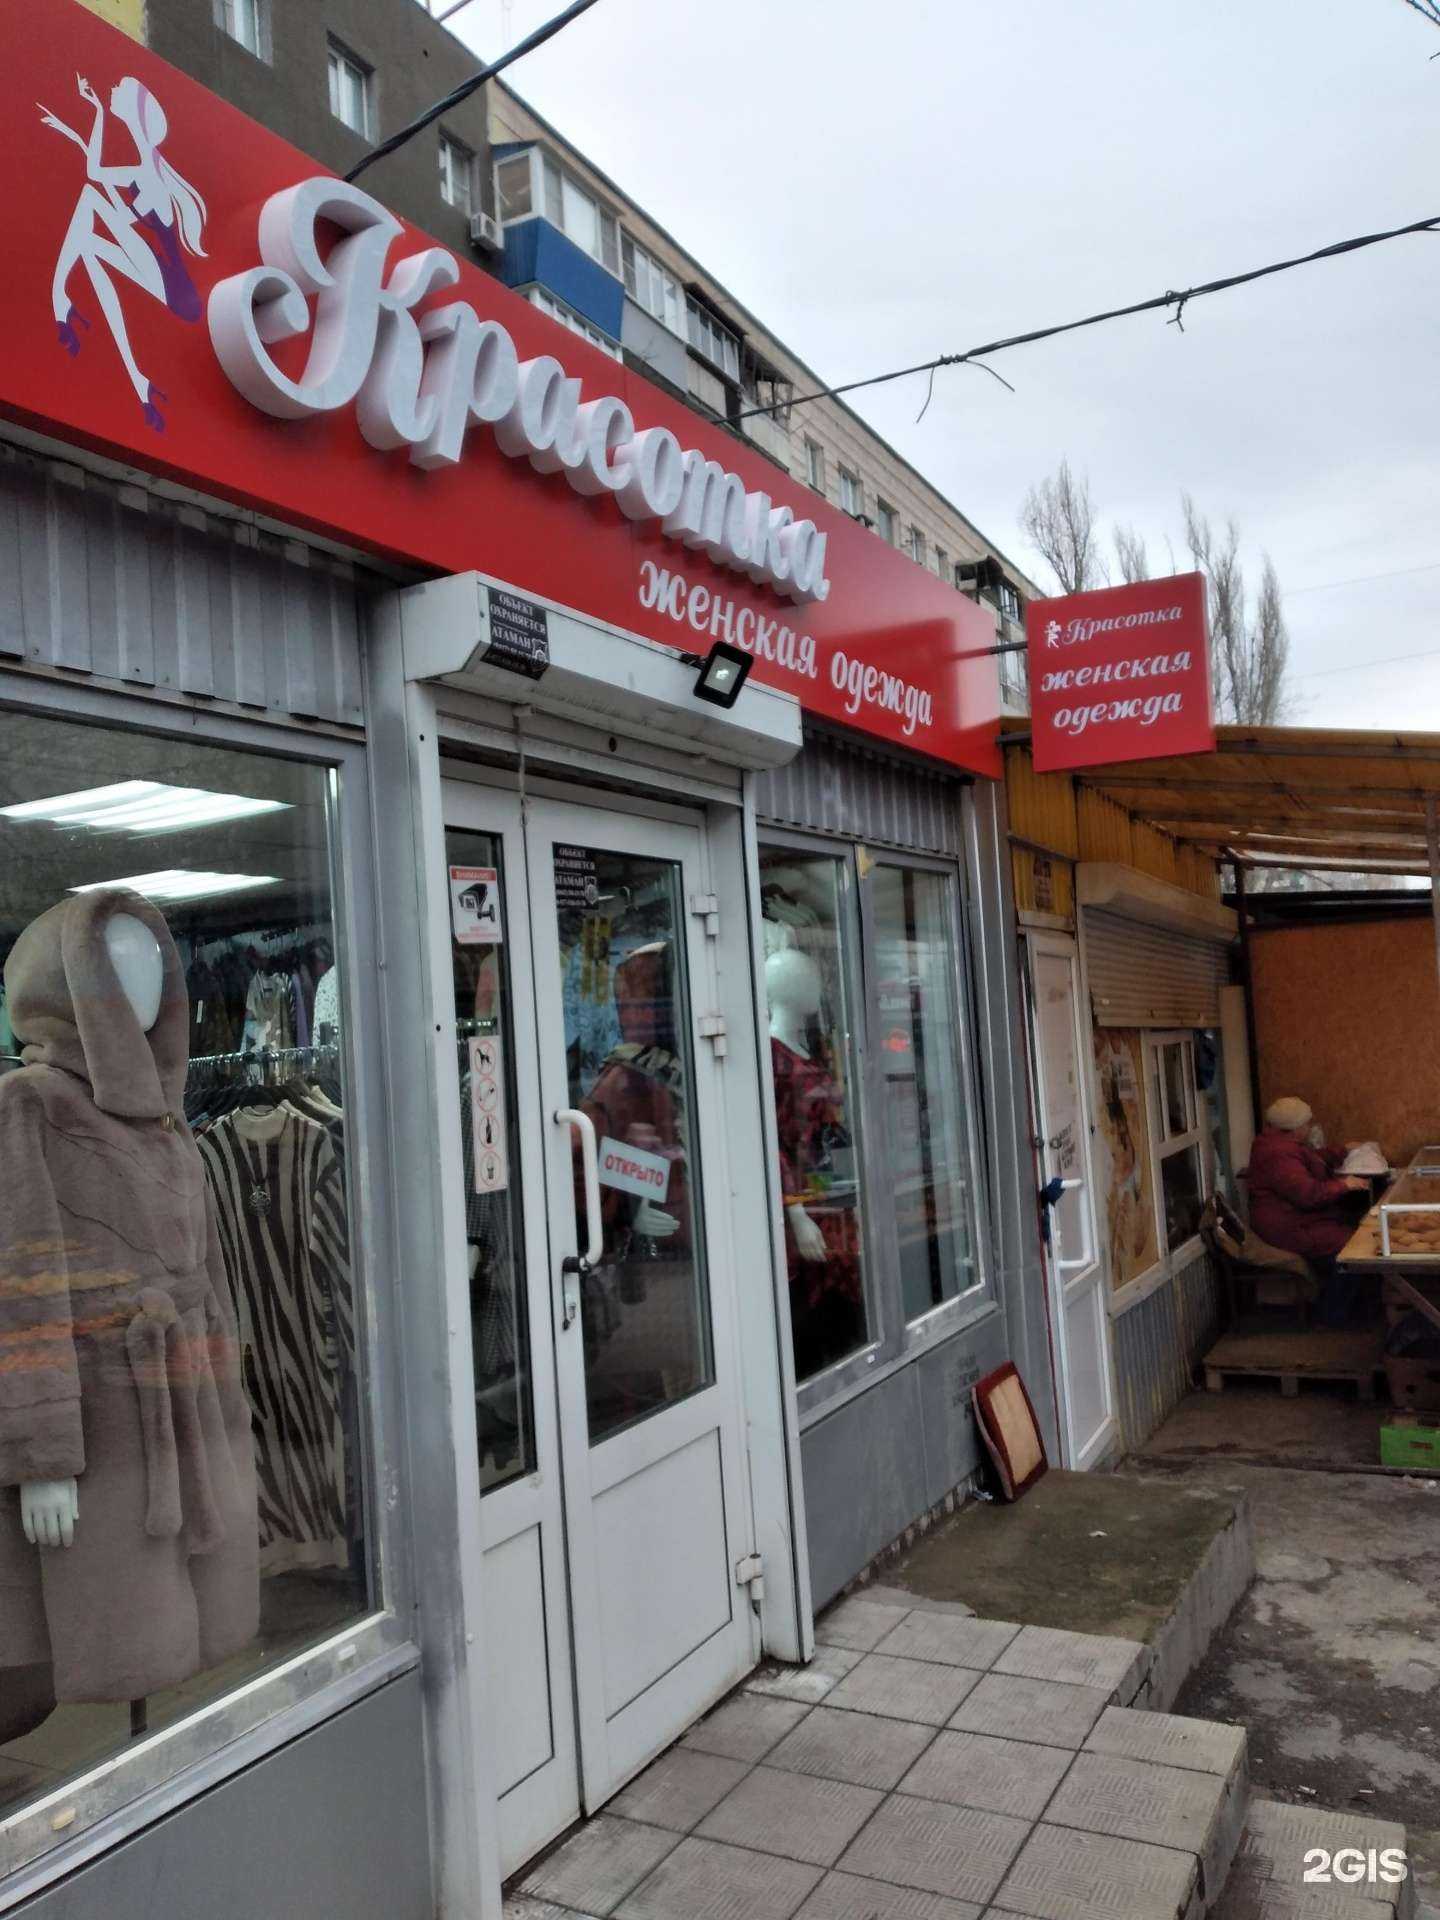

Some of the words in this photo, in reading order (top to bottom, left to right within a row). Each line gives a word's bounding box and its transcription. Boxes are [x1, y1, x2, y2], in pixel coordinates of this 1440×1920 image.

[207, 177, 831, 605] Красотка
[490, 604, 546, 635] ОХРАНЯЕТСЯ
[499, 593, 533, 616] ОБЪЕКТ
[491, 625, 531, 649] АТАМАН
[1062, 606, 1182, 645] Красотка
[638, 560, 818, 679] женская
[831, 651, 932, 735] одежда
[1041, 650, 1192, 692] женская
[1053, 692, 1182, 736] одежда
